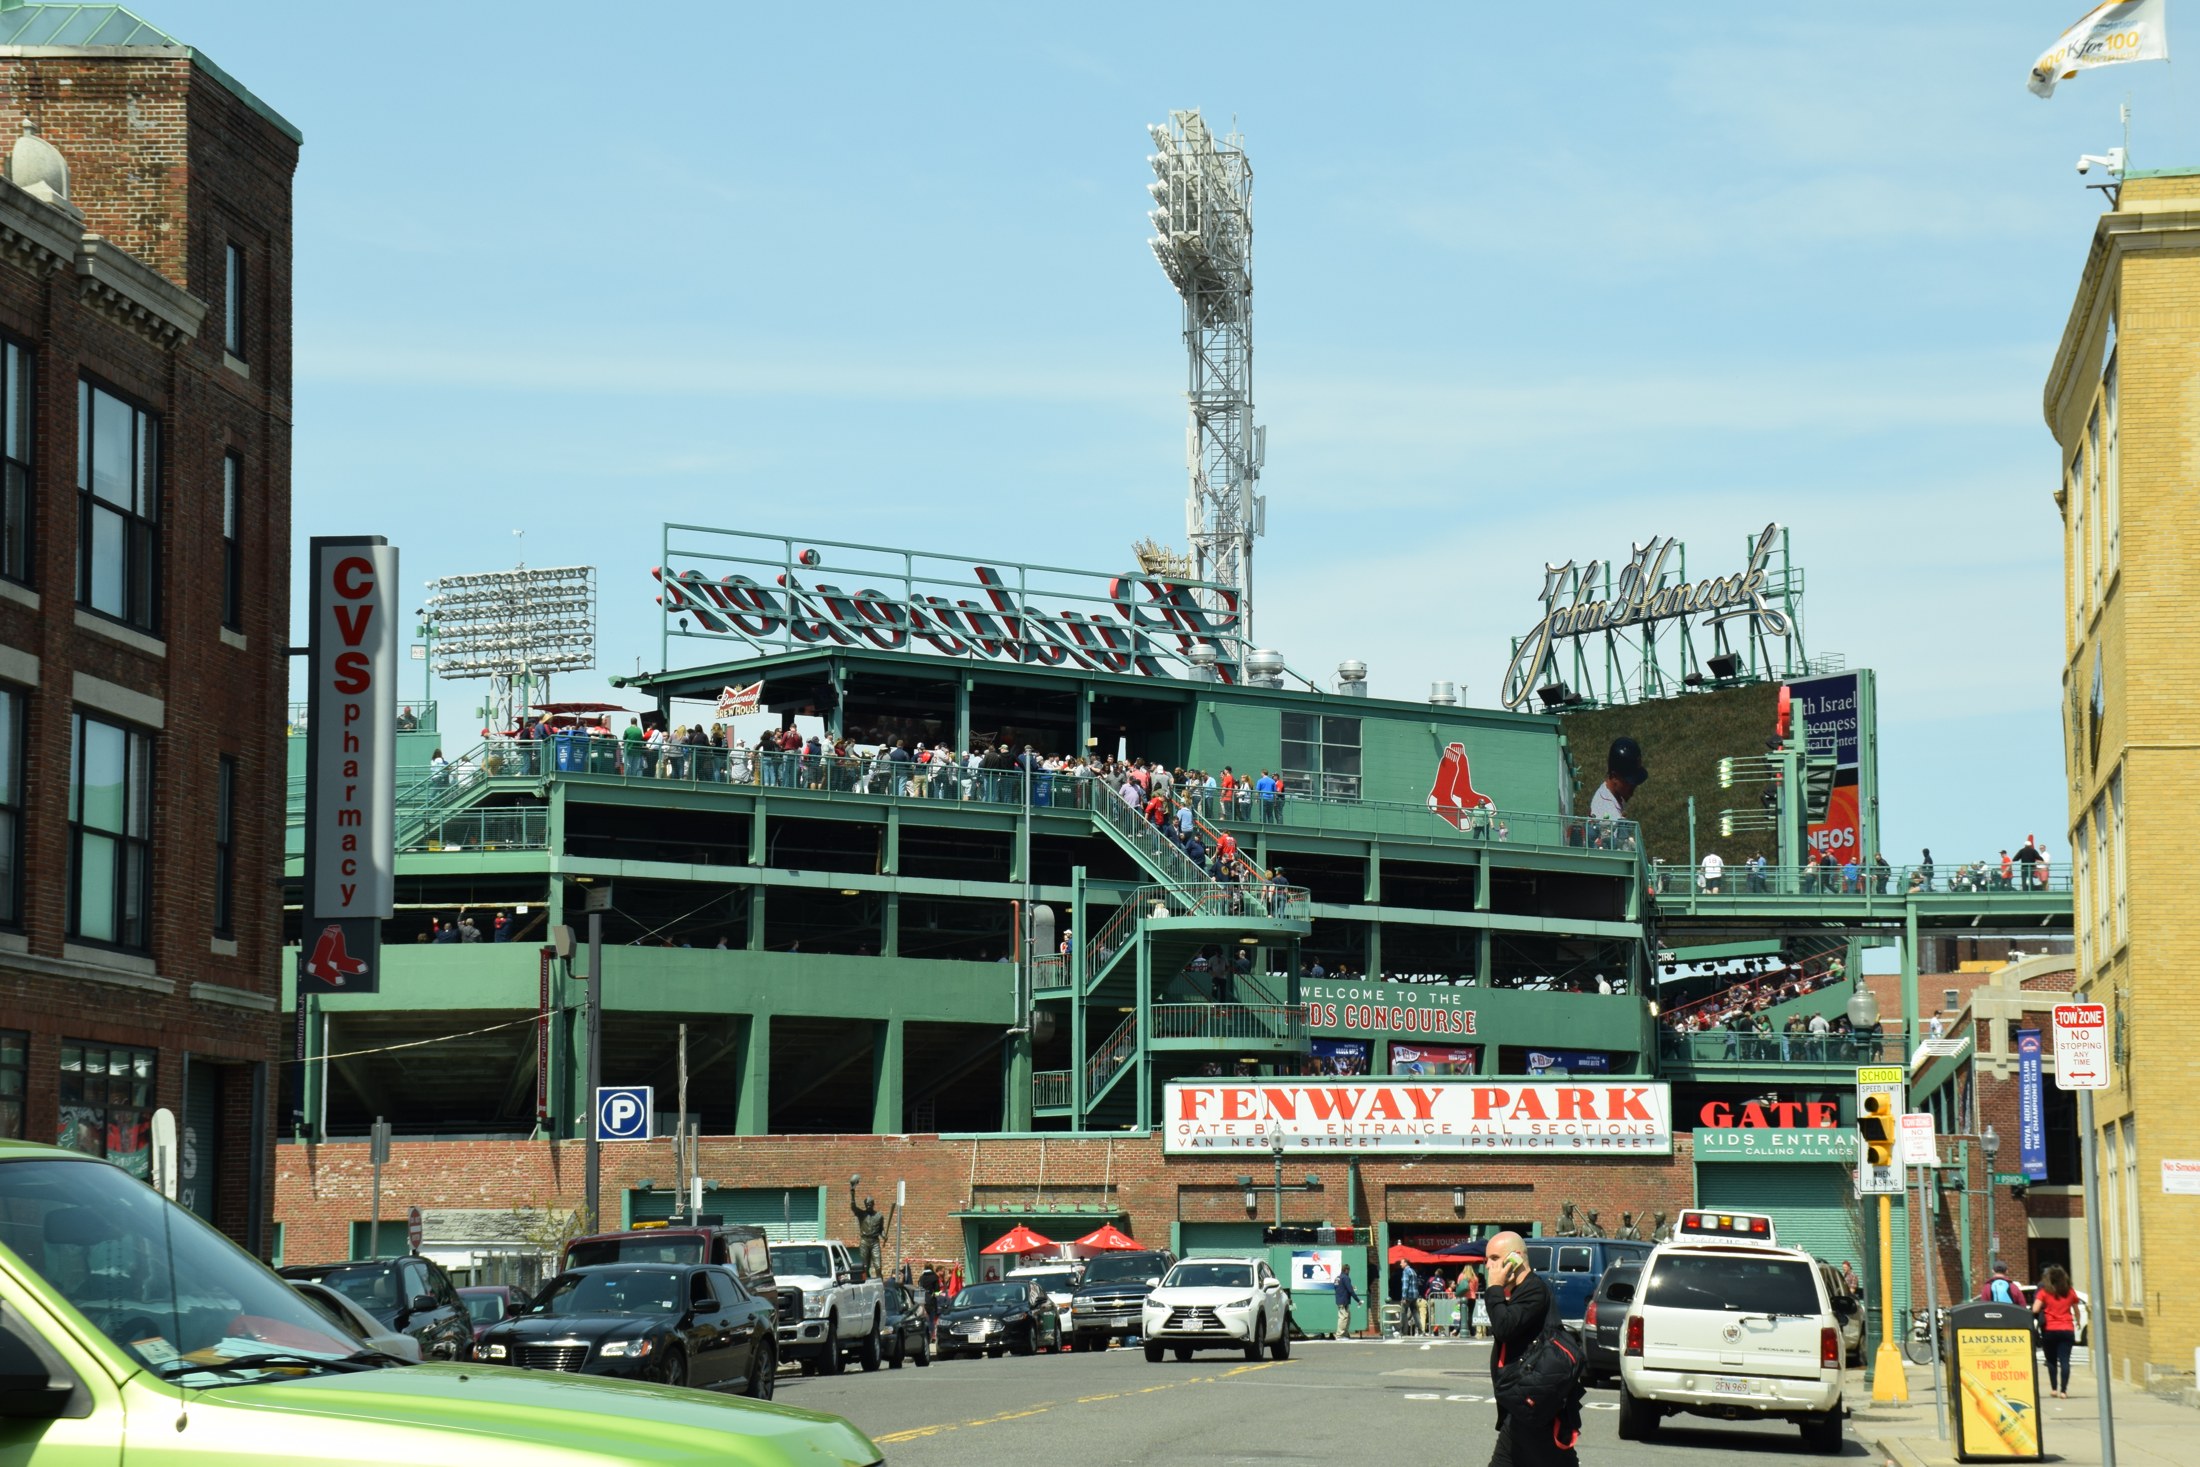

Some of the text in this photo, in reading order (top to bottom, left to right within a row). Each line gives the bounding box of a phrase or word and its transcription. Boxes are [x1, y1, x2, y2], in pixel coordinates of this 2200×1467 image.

[2105, 31, 2140, 51] 100
[1501, 522, 1792, 709] John Hancock
[331, 555, 375, 696] CVS
[717, 691, 760, 708] Budweiser
[1820, 690, 1857, 713] Israel
[715, 704, 759, 719] BREW HOUSE
[337, 703, 363, 908] pharmacy
[1300, 986, 1462, 1005] WELCOME TO THE
[1345, 1004, 1477, 1035] CONCOURSE
[2058, 1011, 2102, 1025] TOW ZONE
[2071, 1030, 2090, 1041] NO
[2060, 1042, 2102, 1050] STOPPING
[1861, 1070, 1899, 1082] SCHOOL
[1861, 1084, 1899, 1093] SPEED LIMIT
[1178, 1088, 1655, 1121] FENWAY PARK
[2032, 1084, 2040, 1132] CHAMPIONS
[612, 1100, 636, 1129] P
[1700, 1101, 1837, 1129] GATE
[1178, 1124, 1656, 1135] GATE B ENTRANCE ALL SECTIONS
[1178, 1138, 1214, 1147] VAN
[1300, 1138, 1382, 1147] STREET
[1461, 1138, 1555, 1147] IPSWICH
[1572, 1138, 1656, 1147] STREET
[1703, 1134, 1755, 1146] KIDS
[2033, 1134, 2041, 1149] THE
[1873, 1170, 1891, 1178] WHEN
[1866, 1179, 1898, 1187] FLASHING
[959, 1200, 1109, 1212] TICKETS
[1418, 1238, 1434, 1246] TEST
[1437, 1238, 1455, 1246] YOUR
[1961, 1335, 2025, 1344] LANDSHARK
[1976, 1360, 1996, 1370] FINS
[1990, 1371, 2029, 1381] BOSTON!
[1715, 1381, 1747, 1392] 2FN 969
